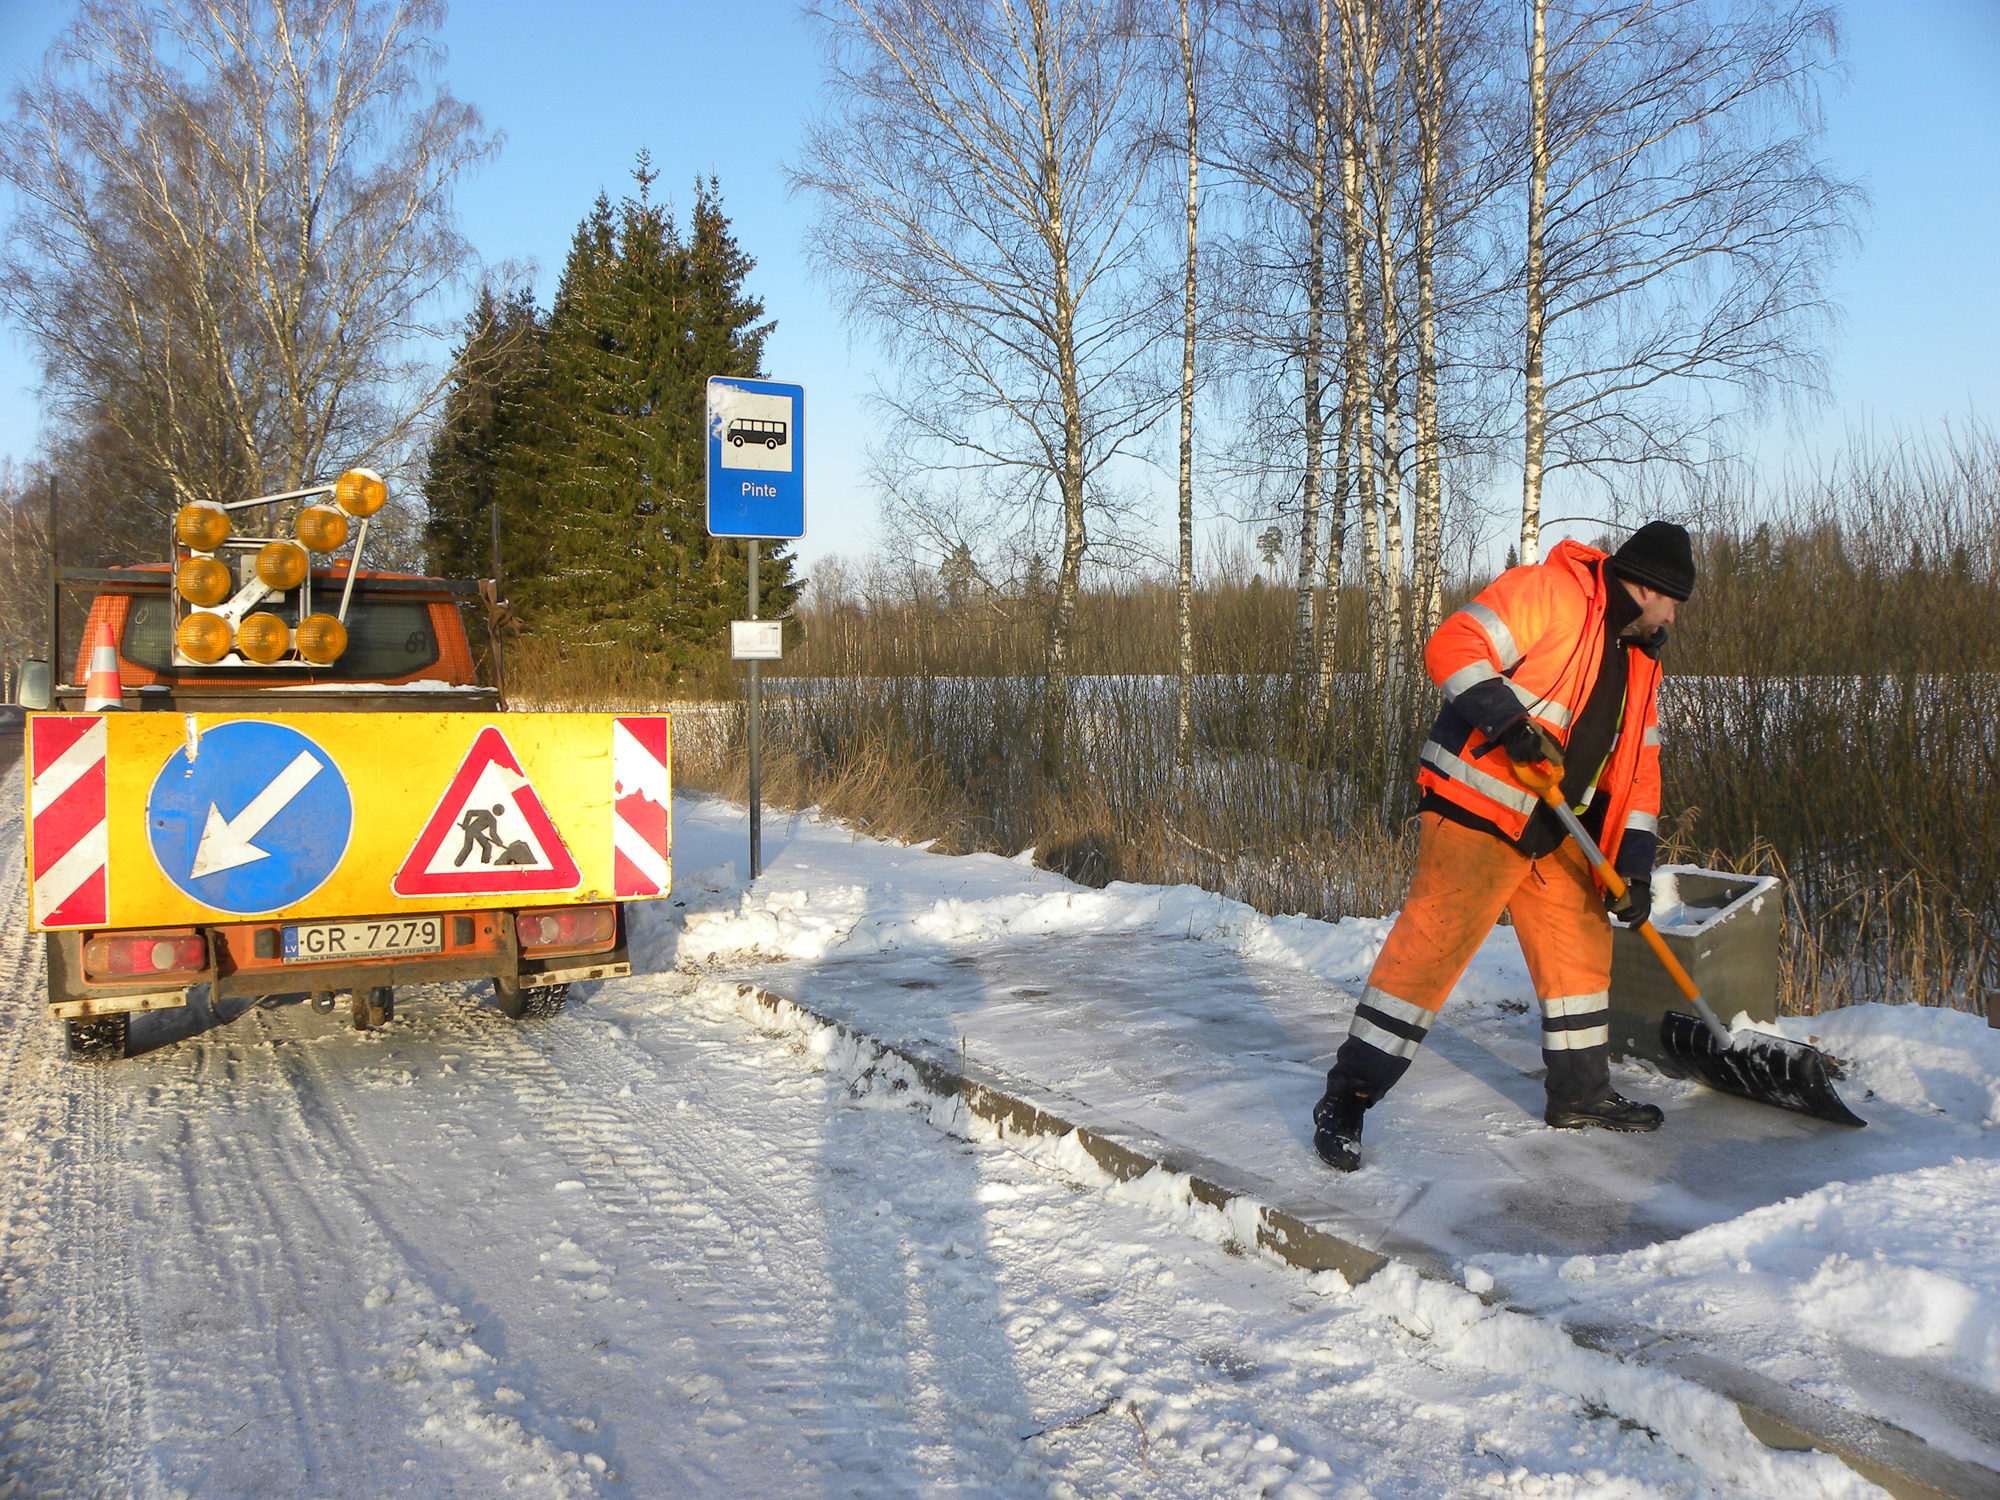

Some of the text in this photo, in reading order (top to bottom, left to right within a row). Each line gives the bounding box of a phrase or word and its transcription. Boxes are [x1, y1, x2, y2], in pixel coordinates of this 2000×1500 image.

[741, 481, 777, 498] Pinte
[306, 921, 436, 953] GR-7279
[285, 945, 297, 953] LV
